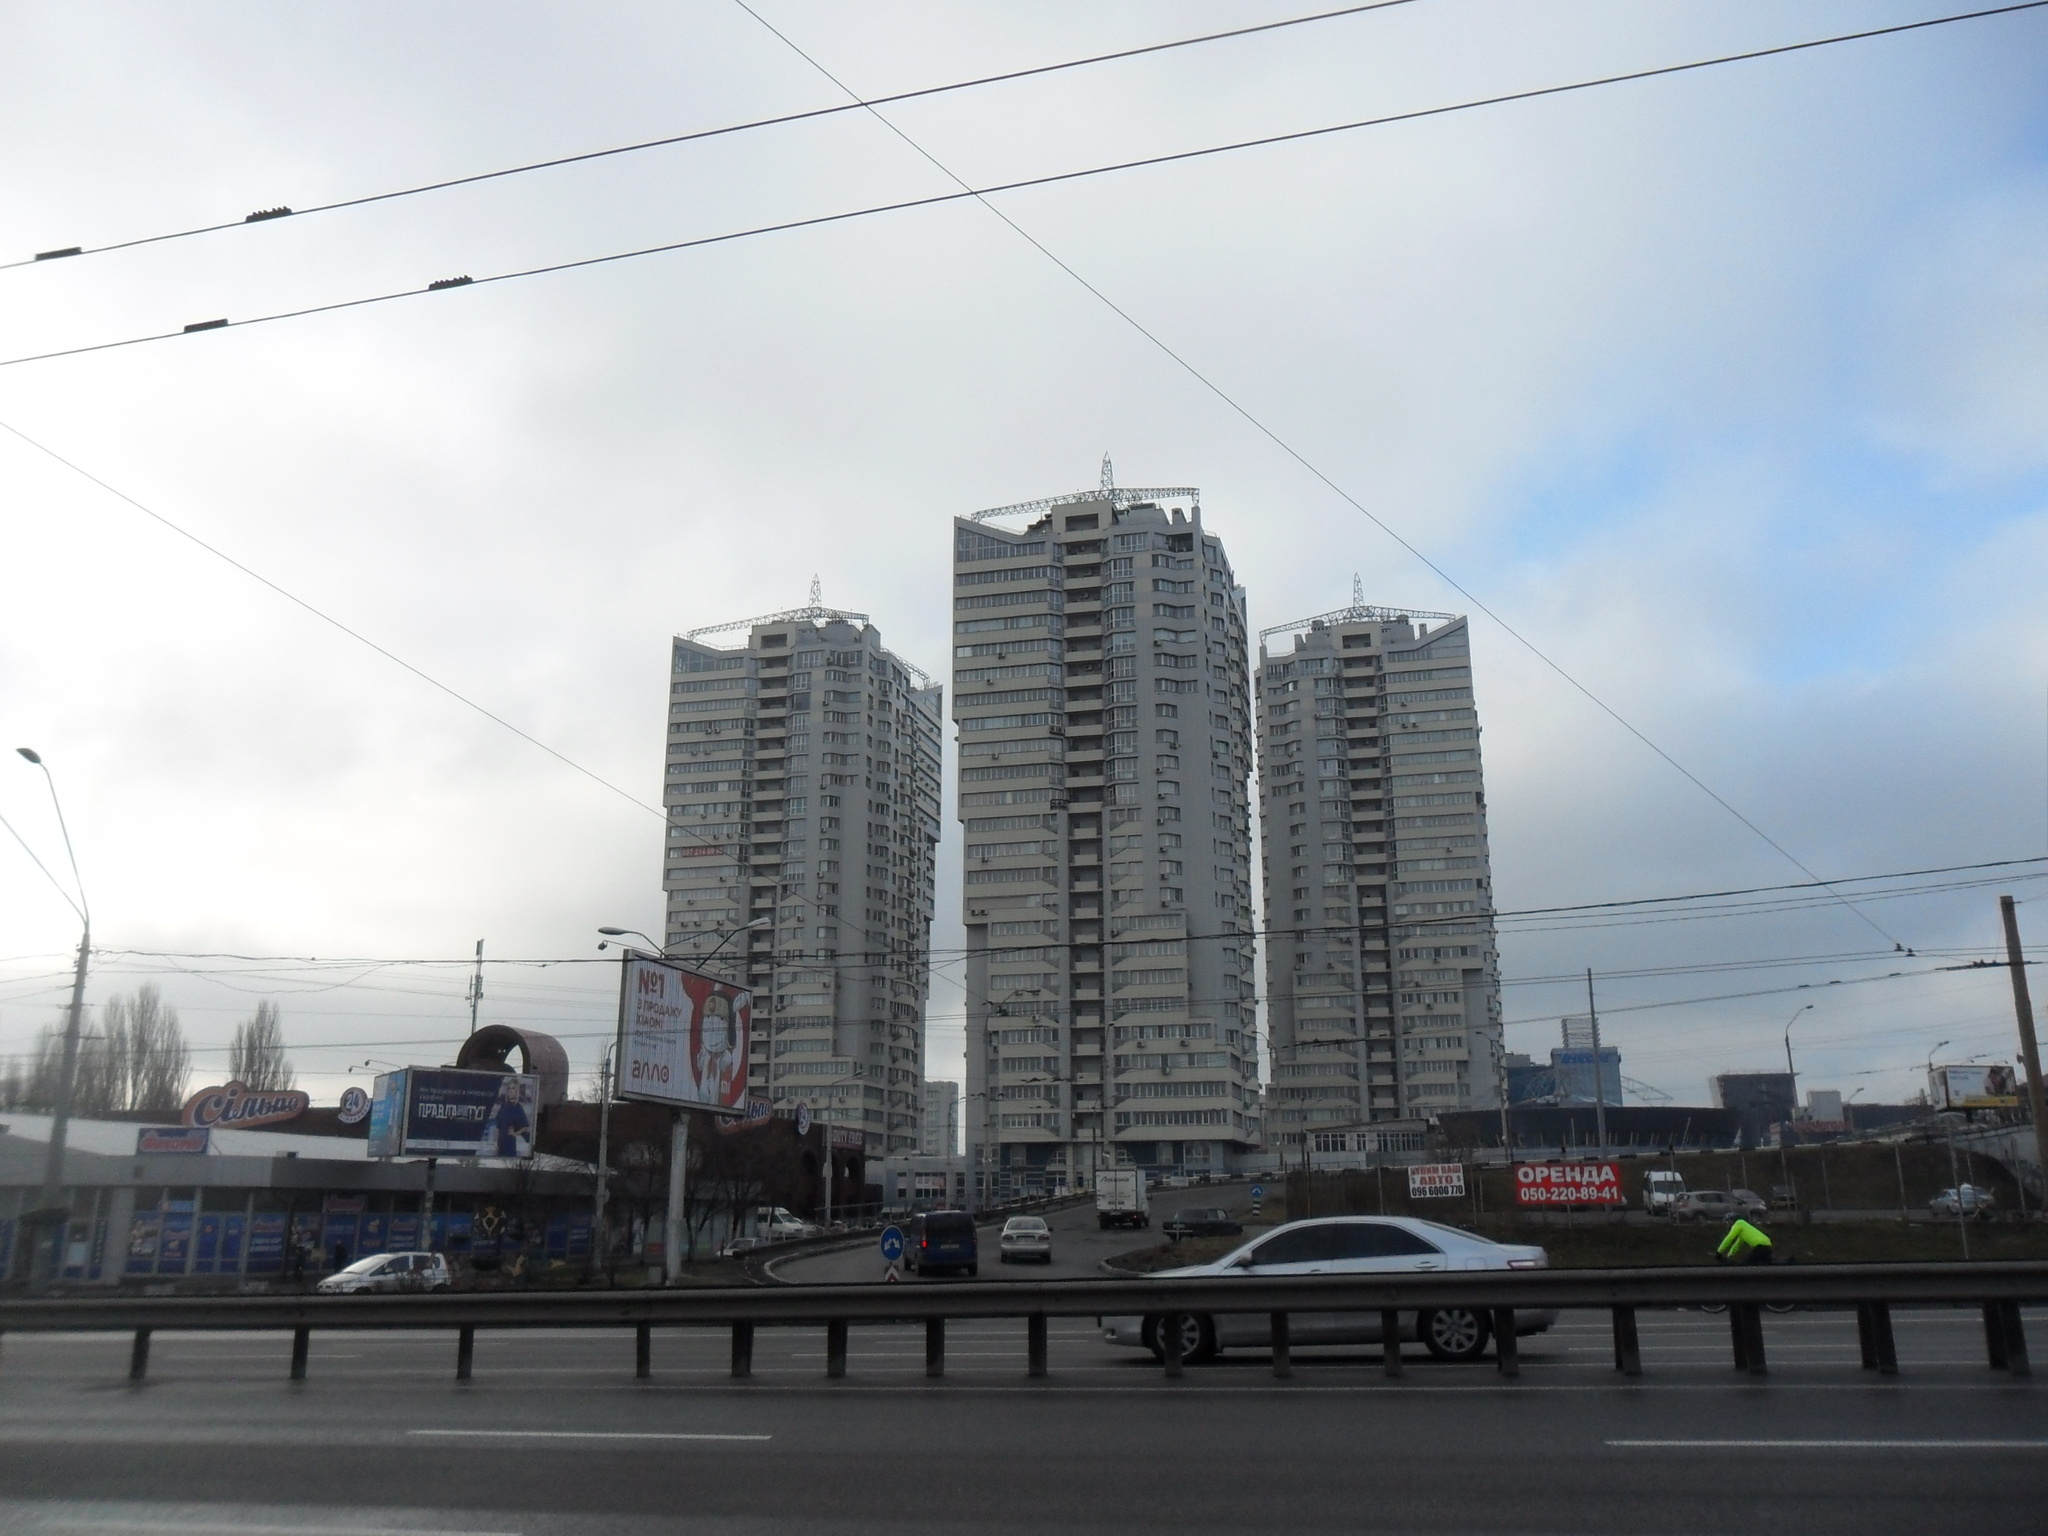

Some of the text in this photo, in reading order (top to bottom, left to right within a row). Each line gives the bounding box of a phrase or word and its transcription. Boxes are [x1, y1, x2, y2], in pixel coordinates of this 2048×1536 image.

[643, 1000, 682, 1018] ПРОДАЖУ
[848, 1130, 863, 1145] FREE
[1420, 1175, 1454, 1185] АВТО
[1517, 1165, 1616, 1185] ОРЕНДА
[1412, 1186, 1428, 1197] 096
[1450, 1184, 1464, 1195] 770
[1520, 1186, 1618, 1201] 050-220-89-41
